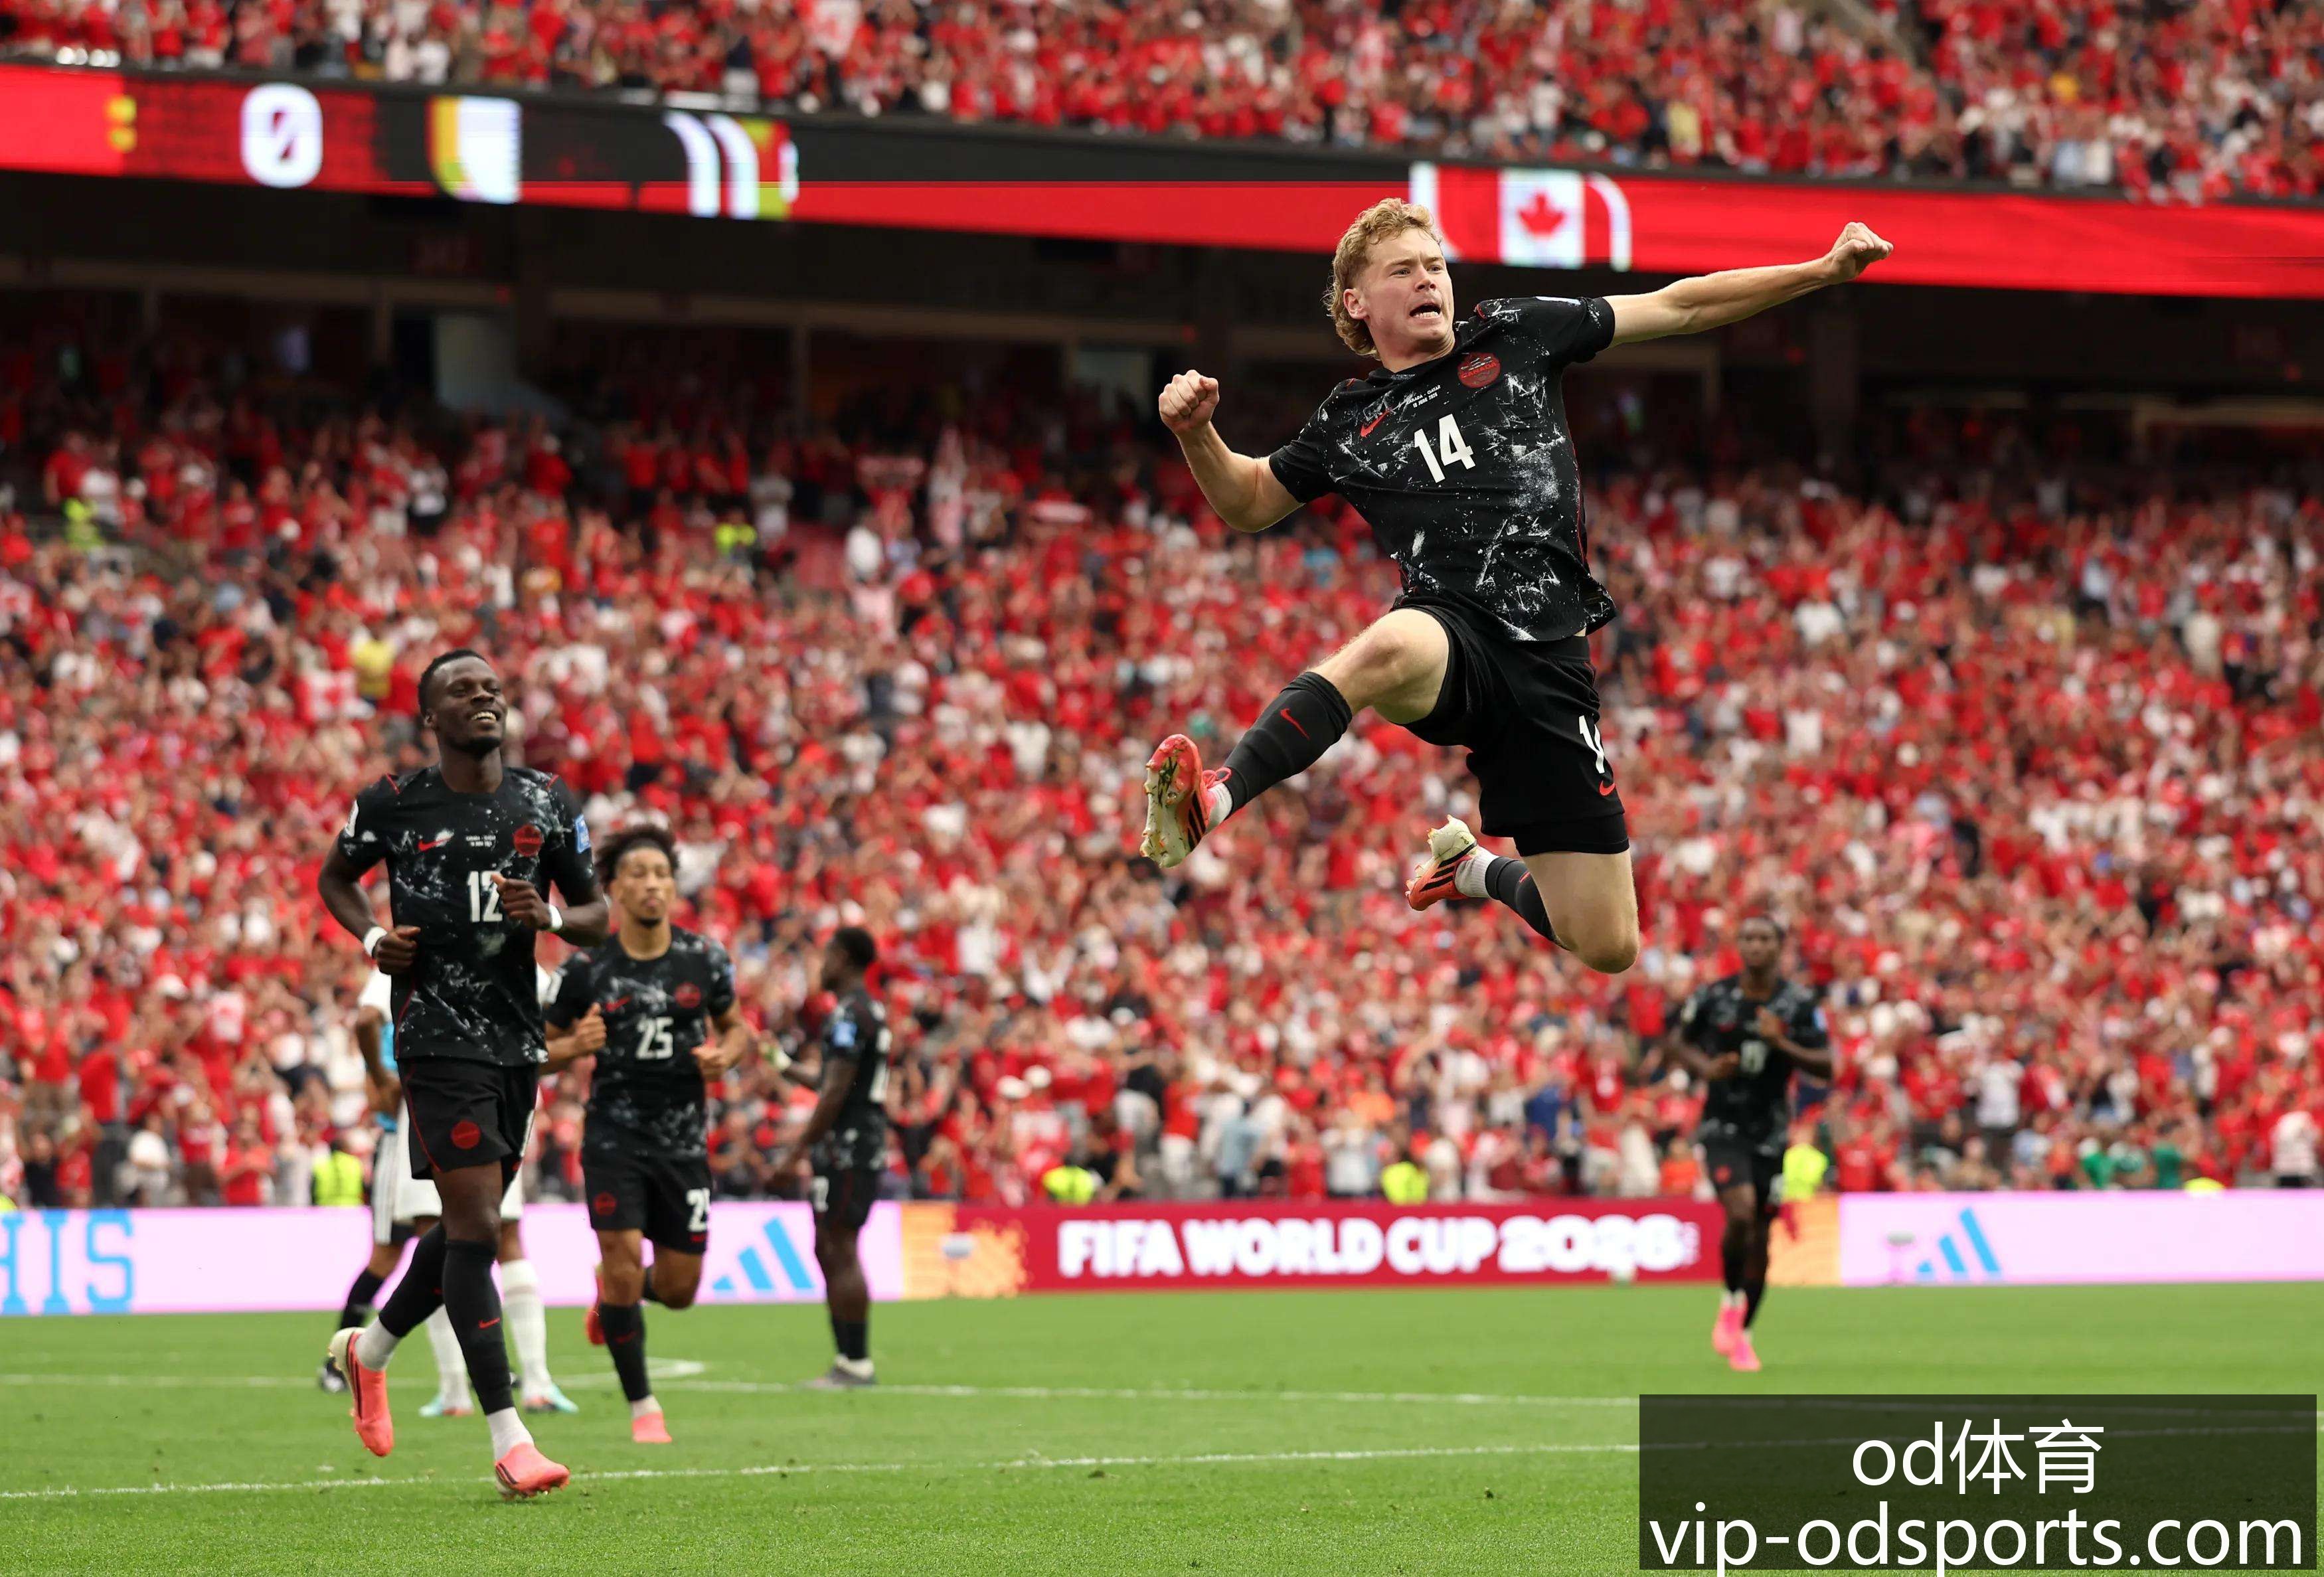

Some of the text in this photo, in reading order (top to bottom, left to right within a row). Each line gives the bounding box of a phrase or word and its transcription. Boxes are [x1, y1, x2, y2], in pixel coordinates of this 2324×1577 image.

[1414, 413, 1475, 483] 14
[467, 870, 503, 922] 12
[636, 1015, 673, 1059] 25
[1058, 1219, 1185, 1277] FIFA
[1181, 1217, 1384, 1276] WORLD
[1385, 1216, 1499, 1274] CUP
[1497, 1213, 1687, 1273] 2026
